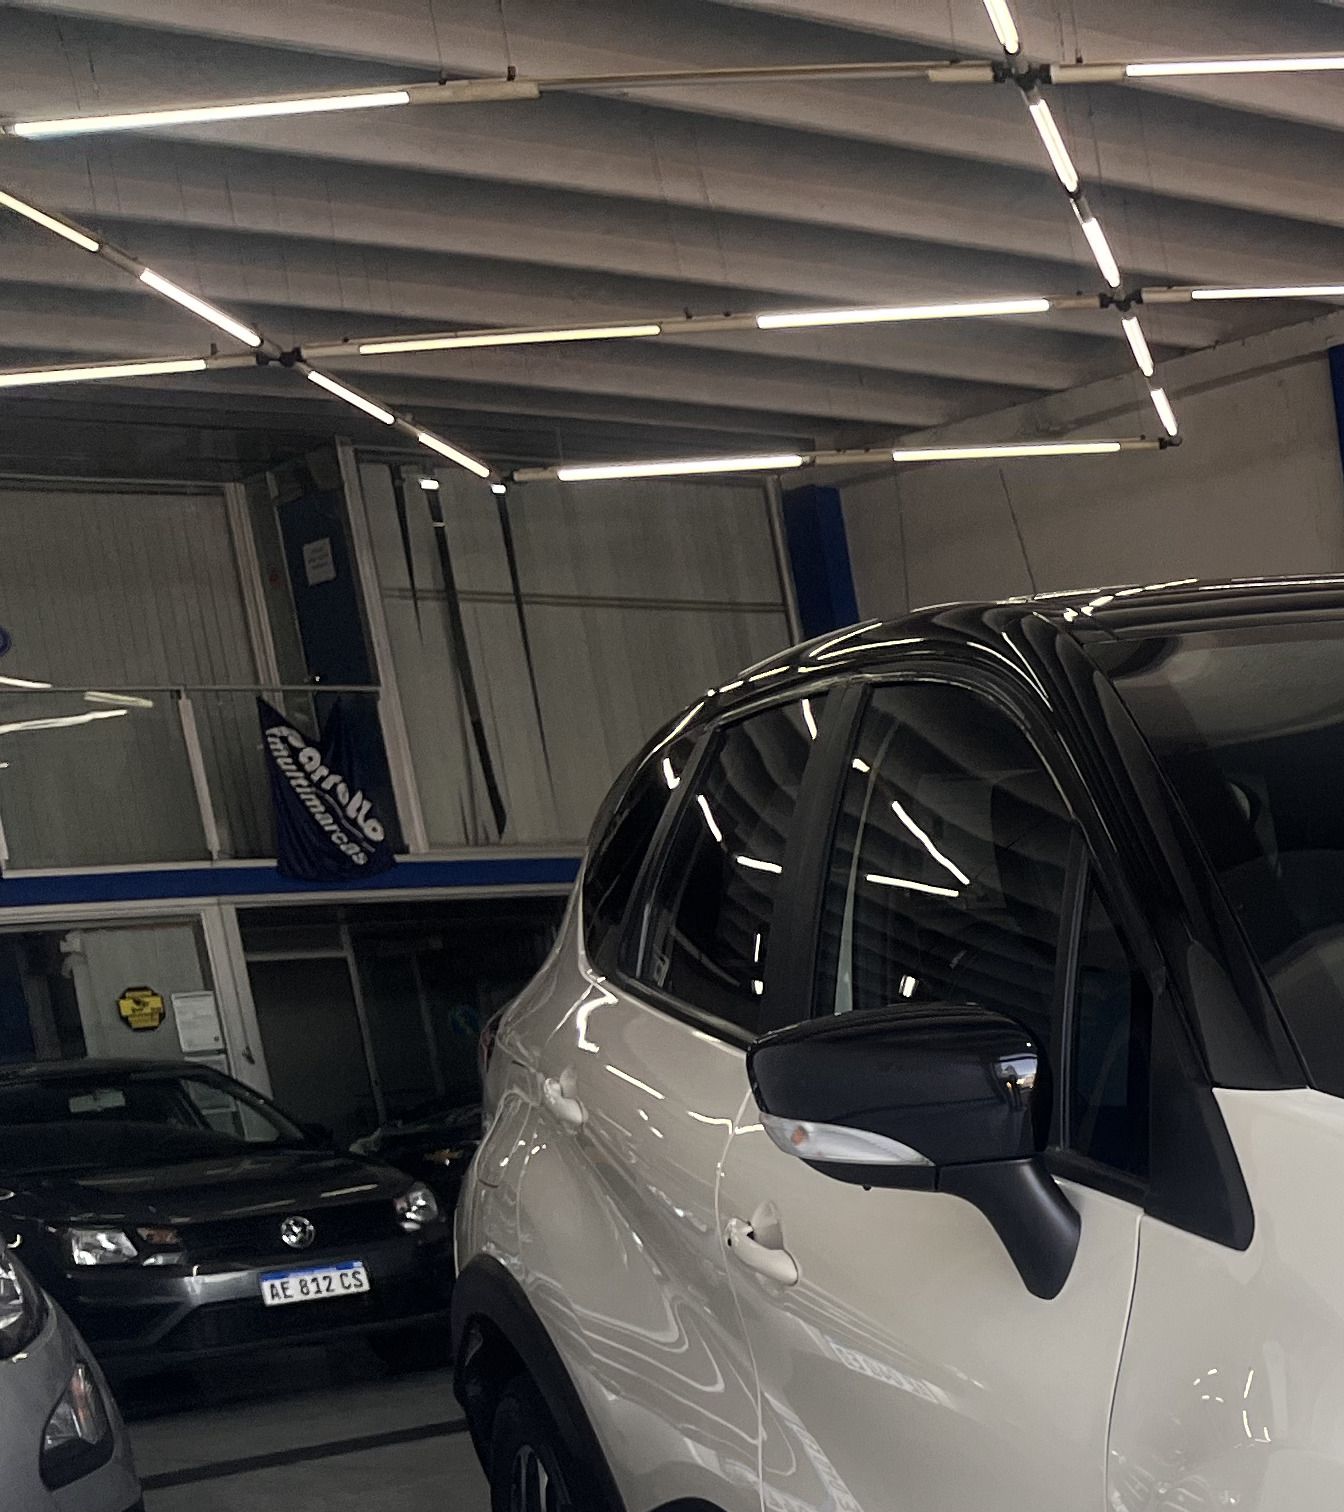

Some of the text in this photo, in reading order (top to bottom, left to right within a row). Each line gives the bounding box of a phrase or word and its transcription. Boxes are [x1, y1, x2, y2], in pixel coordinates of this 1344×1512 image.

[270, 1280, 293, 1301] AE
[299, 1275, 335, 1296] 812
[340, 1270, 364, 1290] CS
